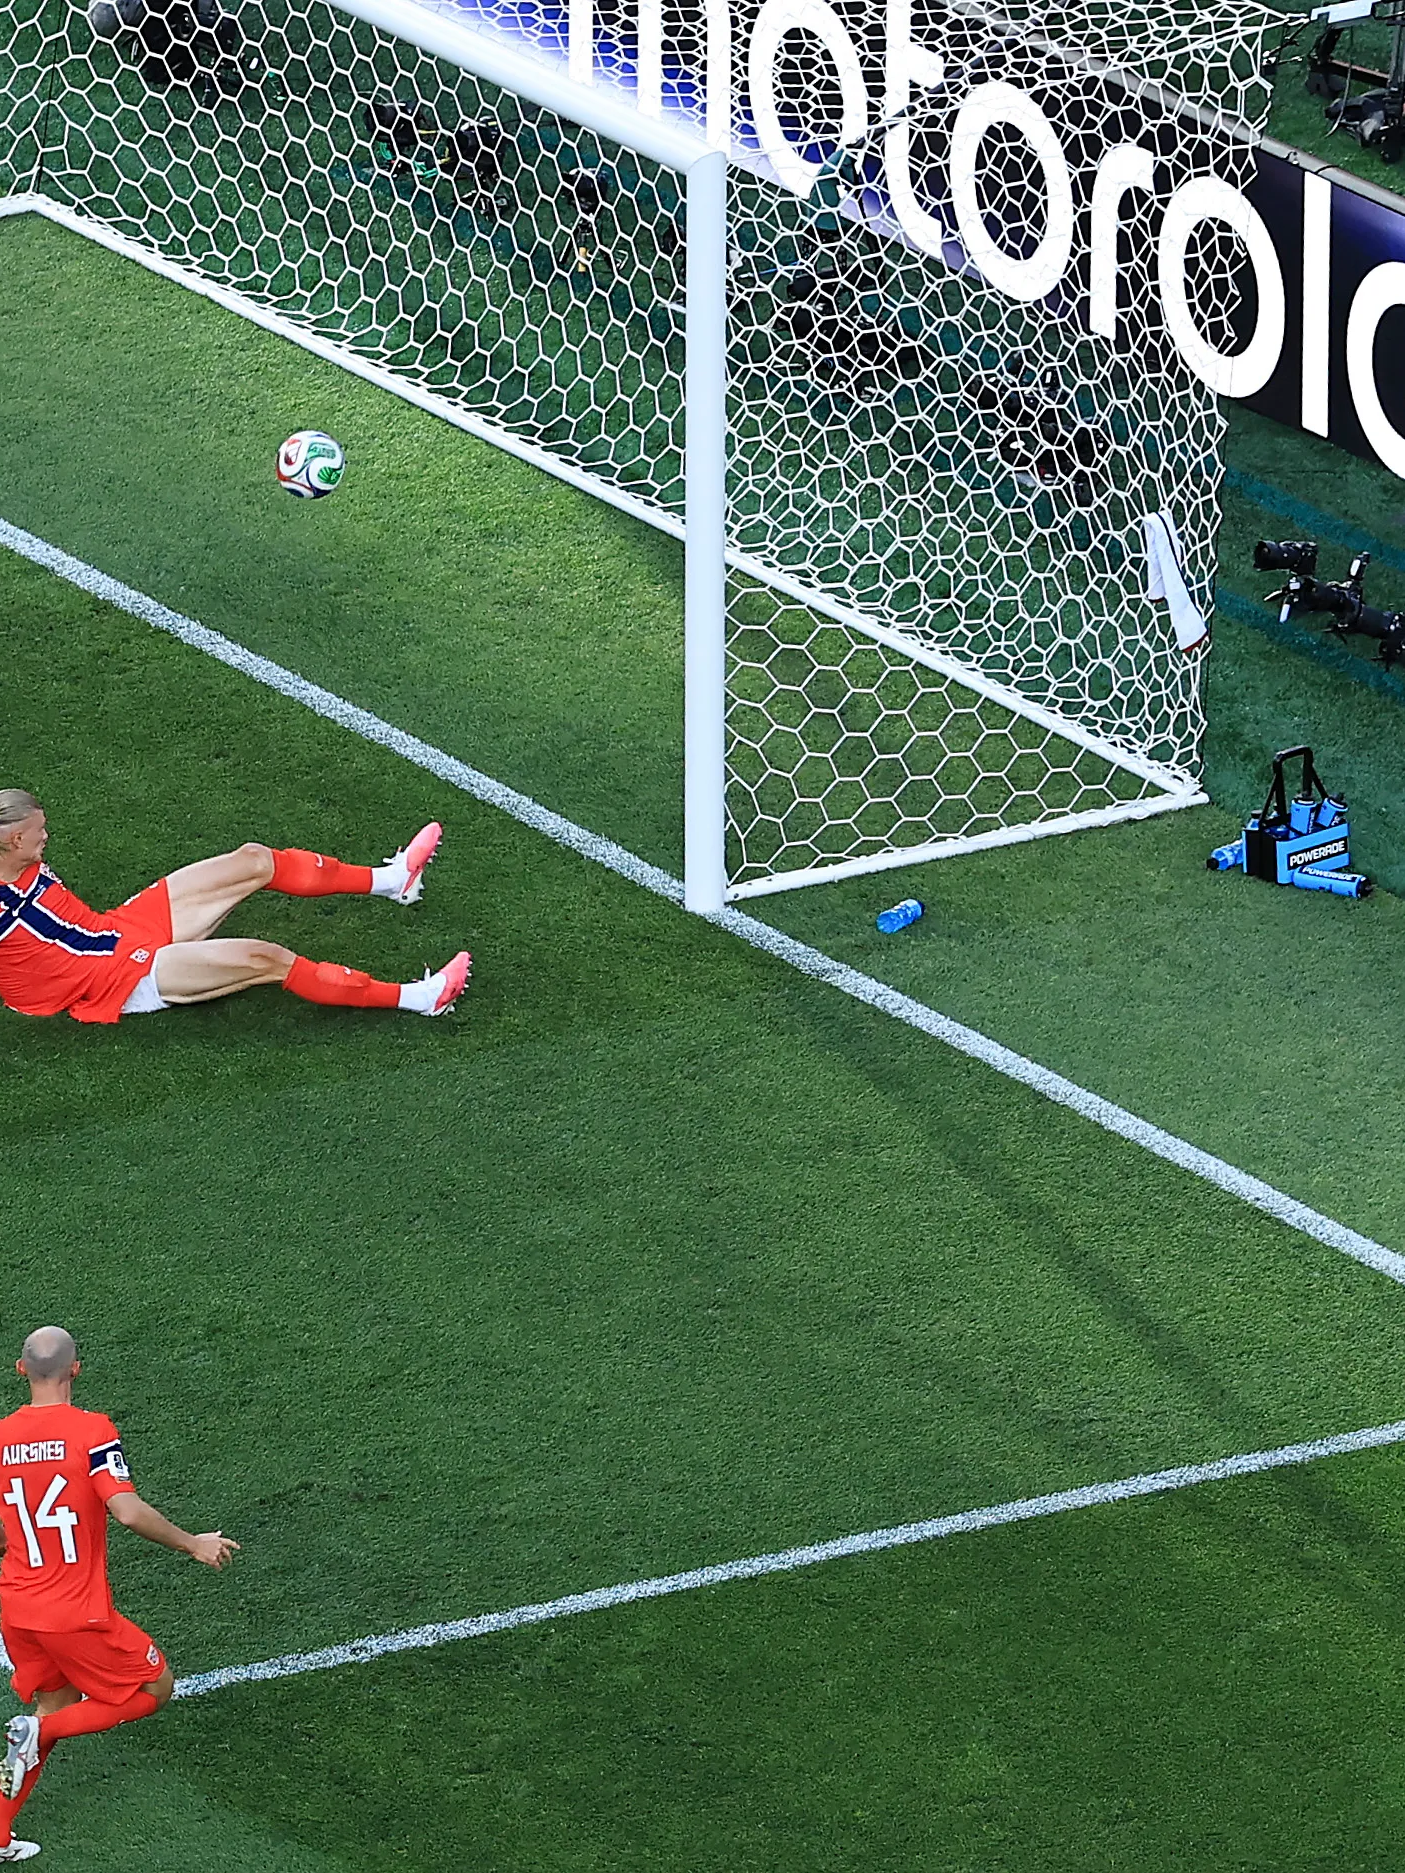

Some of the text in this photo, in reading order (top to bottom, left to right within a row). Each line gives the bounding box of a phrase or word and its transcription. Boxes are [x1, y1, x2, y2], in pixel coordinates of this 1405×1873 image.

[1289, 840, 1345, 867] POWERADE
[2, 1440, 65, 1466] AURSNES
[3, 1473, 78, 1568] 14
